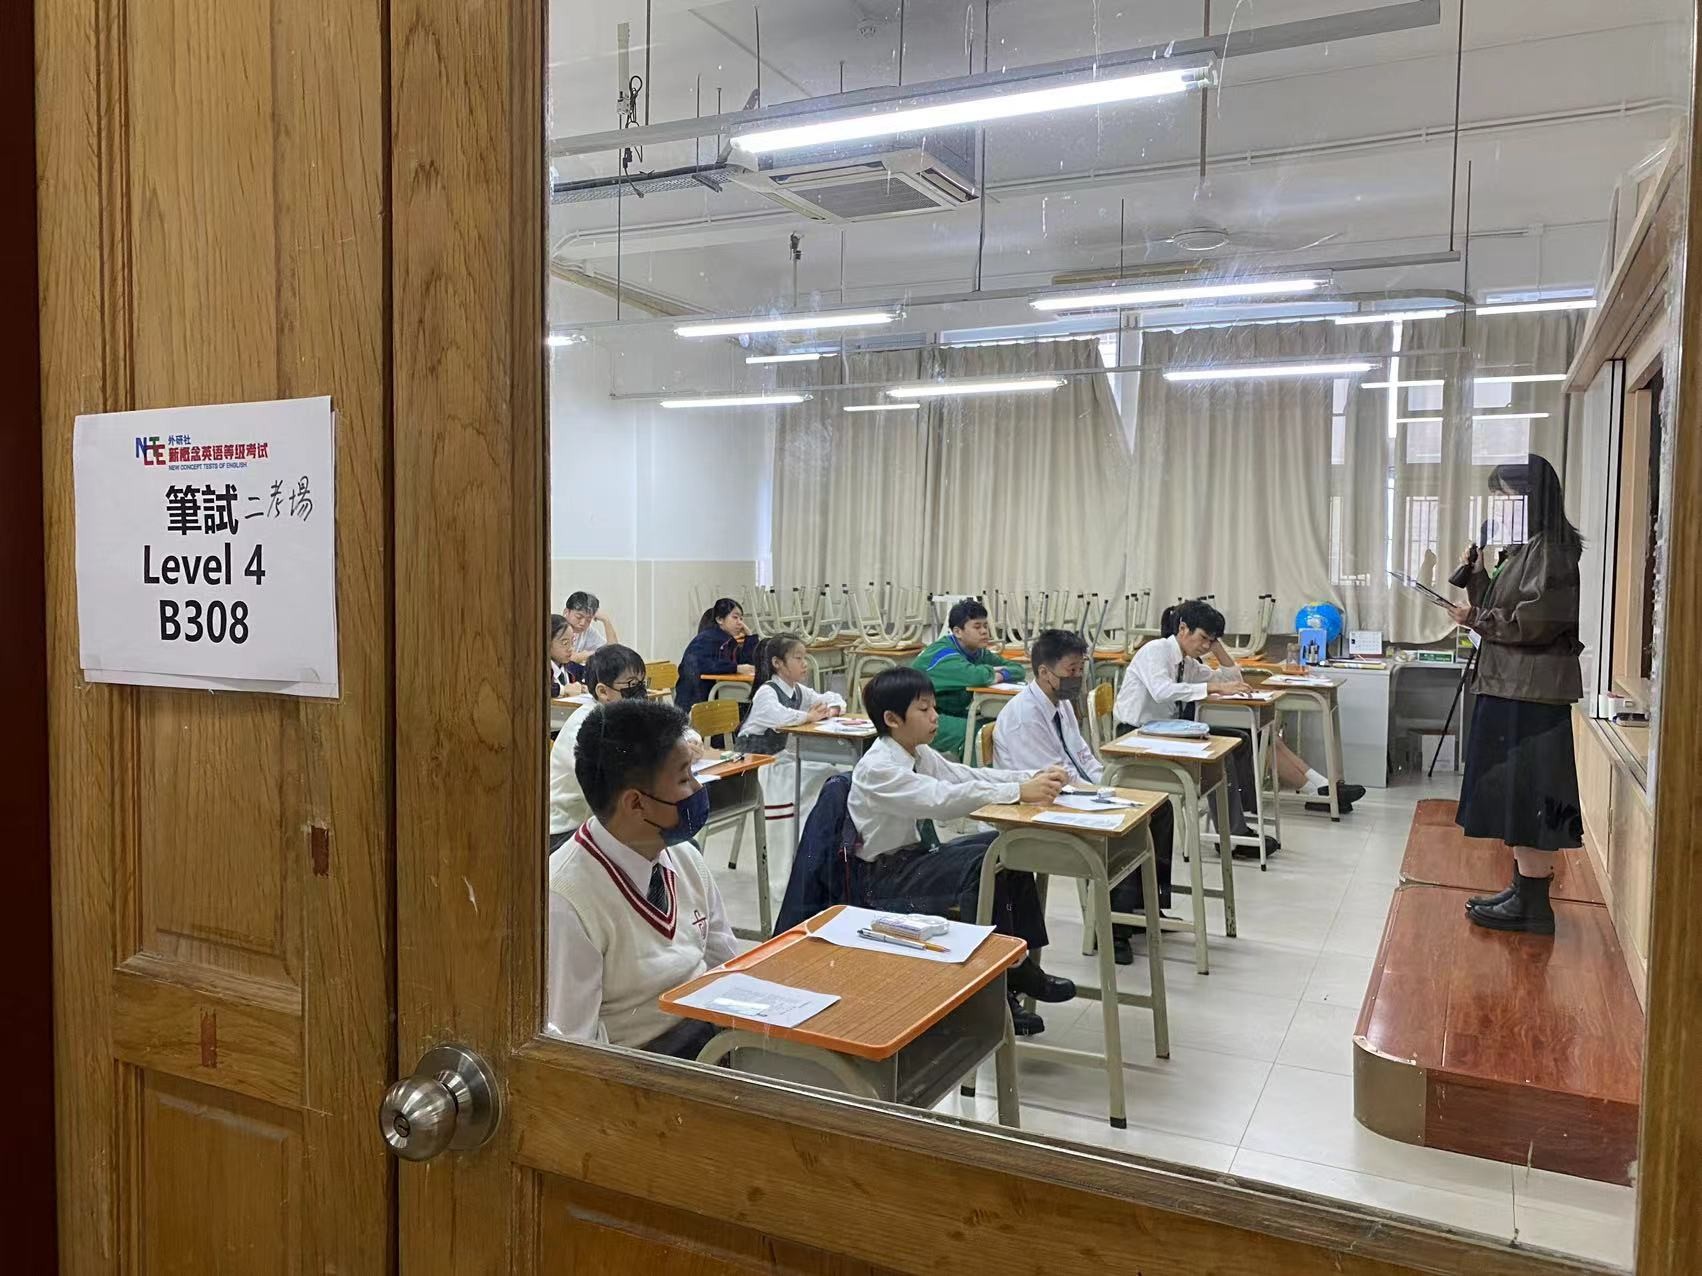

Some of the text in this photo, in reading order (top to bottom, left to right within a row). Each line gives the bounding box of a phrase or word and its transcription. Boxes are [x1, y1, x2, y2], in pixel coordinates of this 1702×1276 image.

[168, 434, 191, 446] 外研社
[168, 442, 268, 463] 新概念英语等级考试
[180, 463, 202, 471] CONCEPT
[226, 461, 248, 469] ENGLISH
[165, 483, 239, 536] 筆試
[143, 542, 266, 586] Level 4
[159, 599, 250, 645] B308
